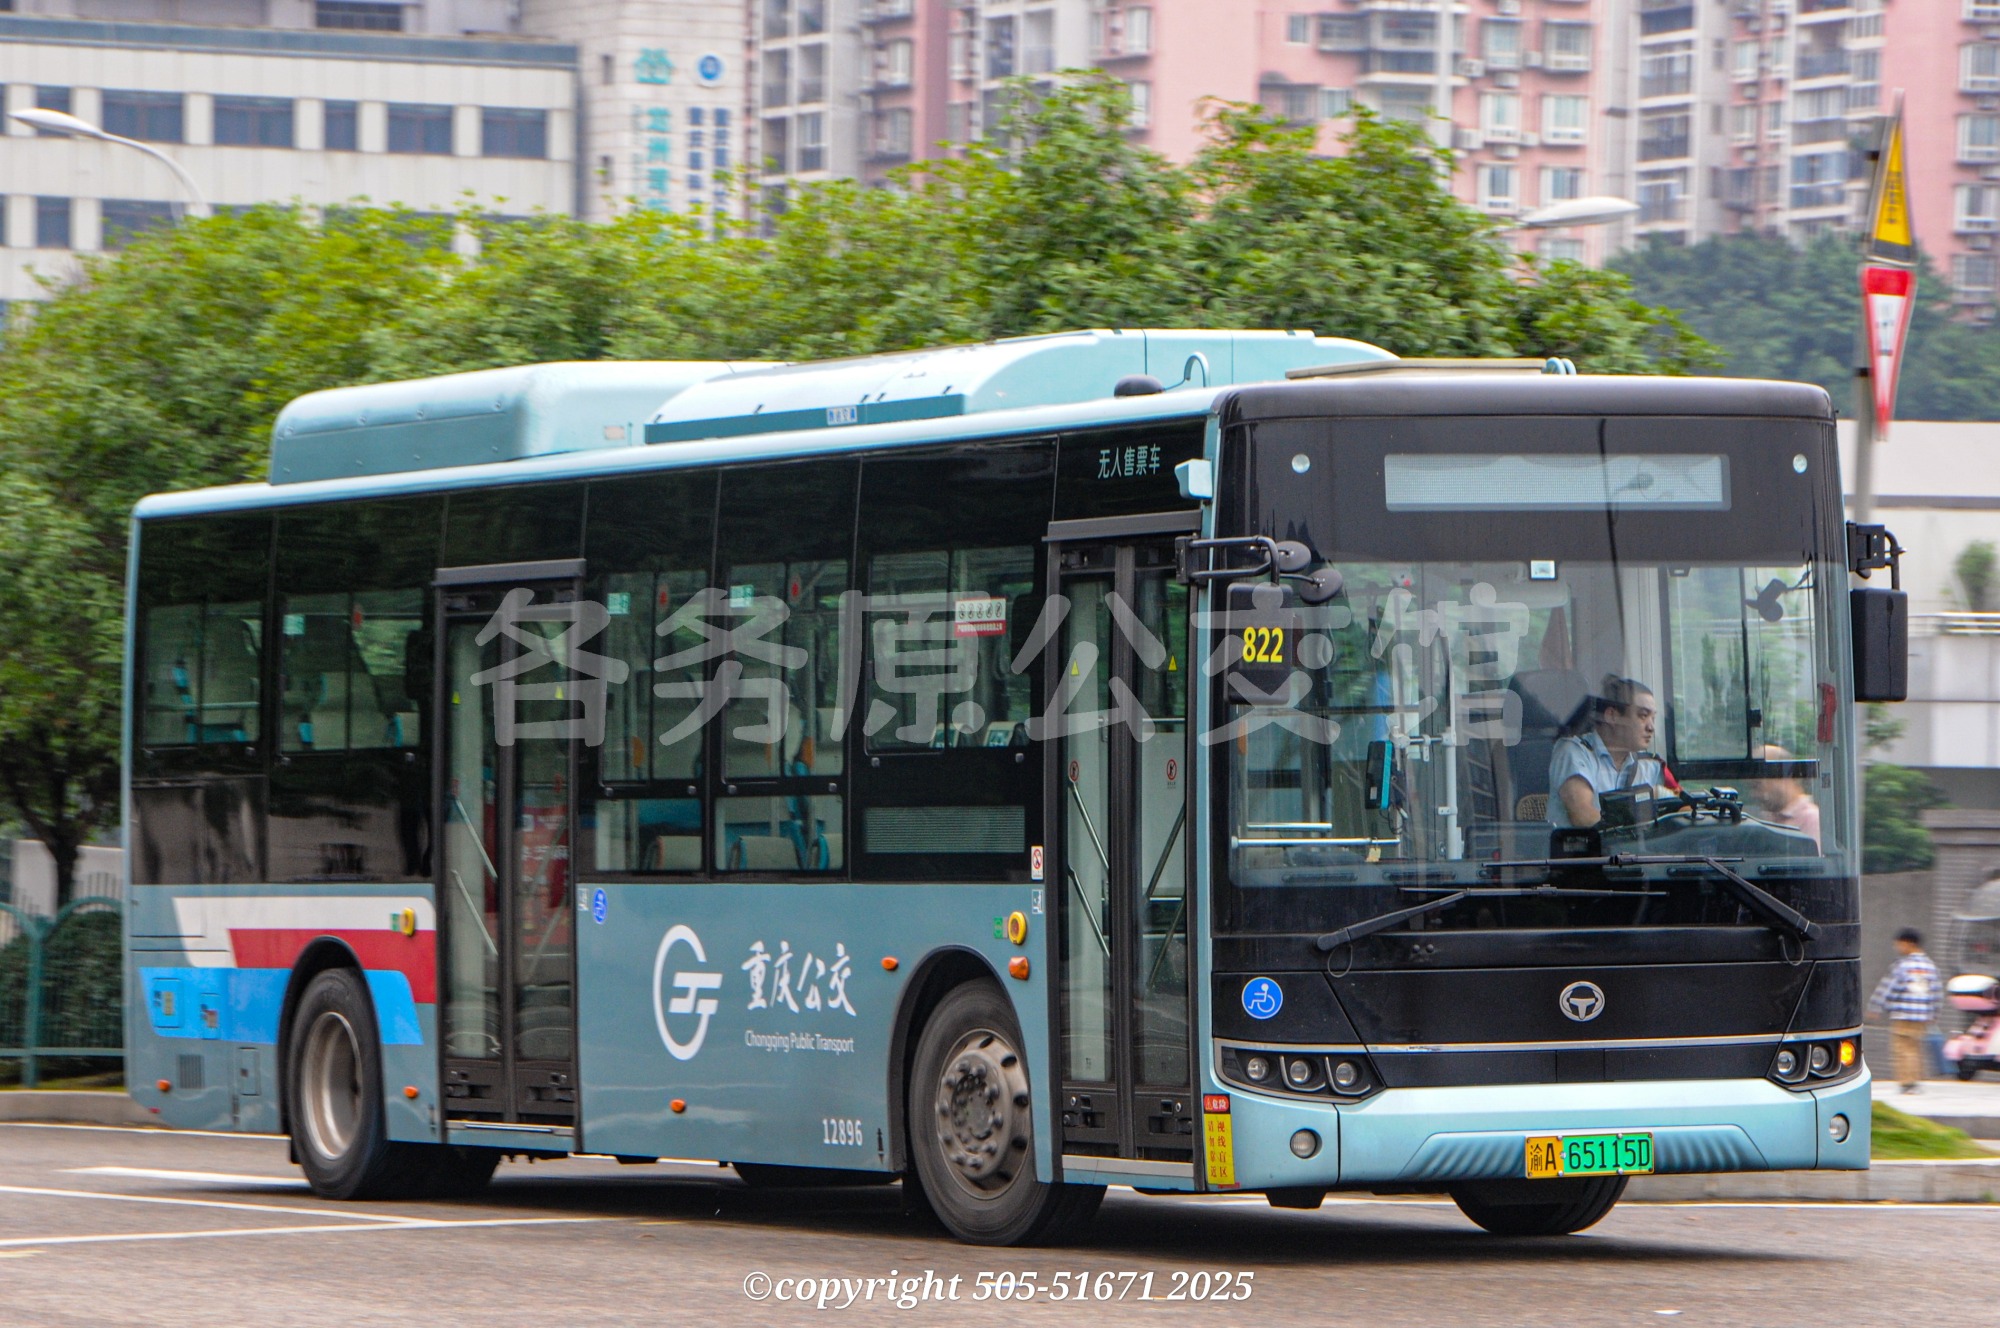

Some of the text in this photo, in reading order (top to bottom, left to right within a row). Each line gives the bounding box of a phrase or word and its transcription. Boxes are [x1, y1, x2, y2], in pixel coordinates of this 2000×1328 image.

[1098, 443, 1160, 479] 无人售票车
[1242, 626, 1284, 663] 822
[741, 940, 857, 1017] 重庆公交
[745, 1030, 854, 1056] Chongqing Public Transport
[822, 1118, 863, 1146] 12896
